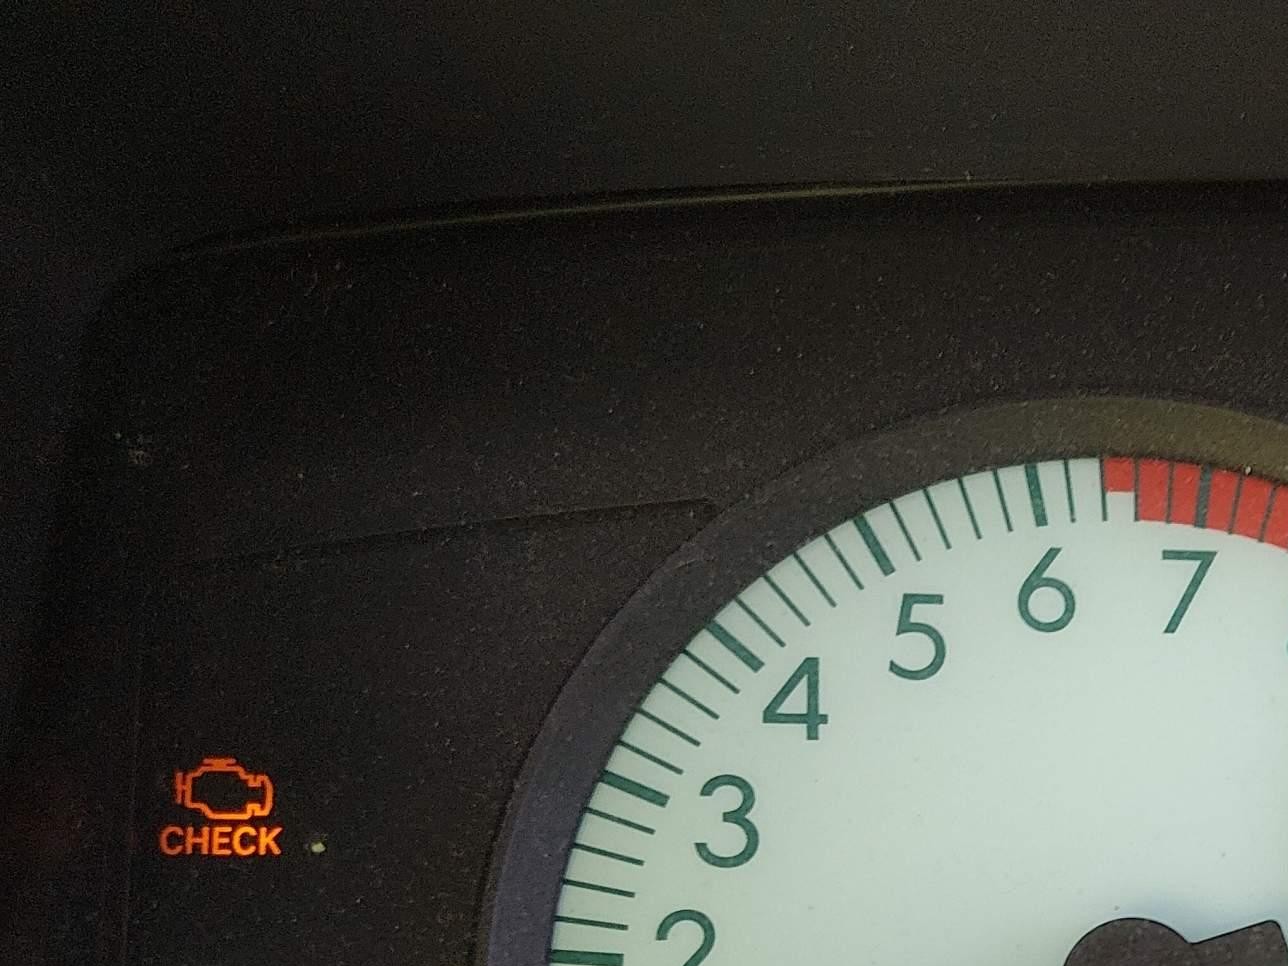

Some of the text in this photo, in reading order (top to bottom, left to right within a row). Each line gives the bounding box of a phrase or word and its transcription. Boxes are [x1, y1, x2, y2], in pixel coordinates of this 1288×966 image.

[1017, 547, 1076, 633] 6
[1161, 549, 1219, 634] 7
[888, 592, 947, 682] 5
[762, 656, 829, 741] 4
[160, 824, 284, 857] CHECK
[694, 774, 760, 868] 3
